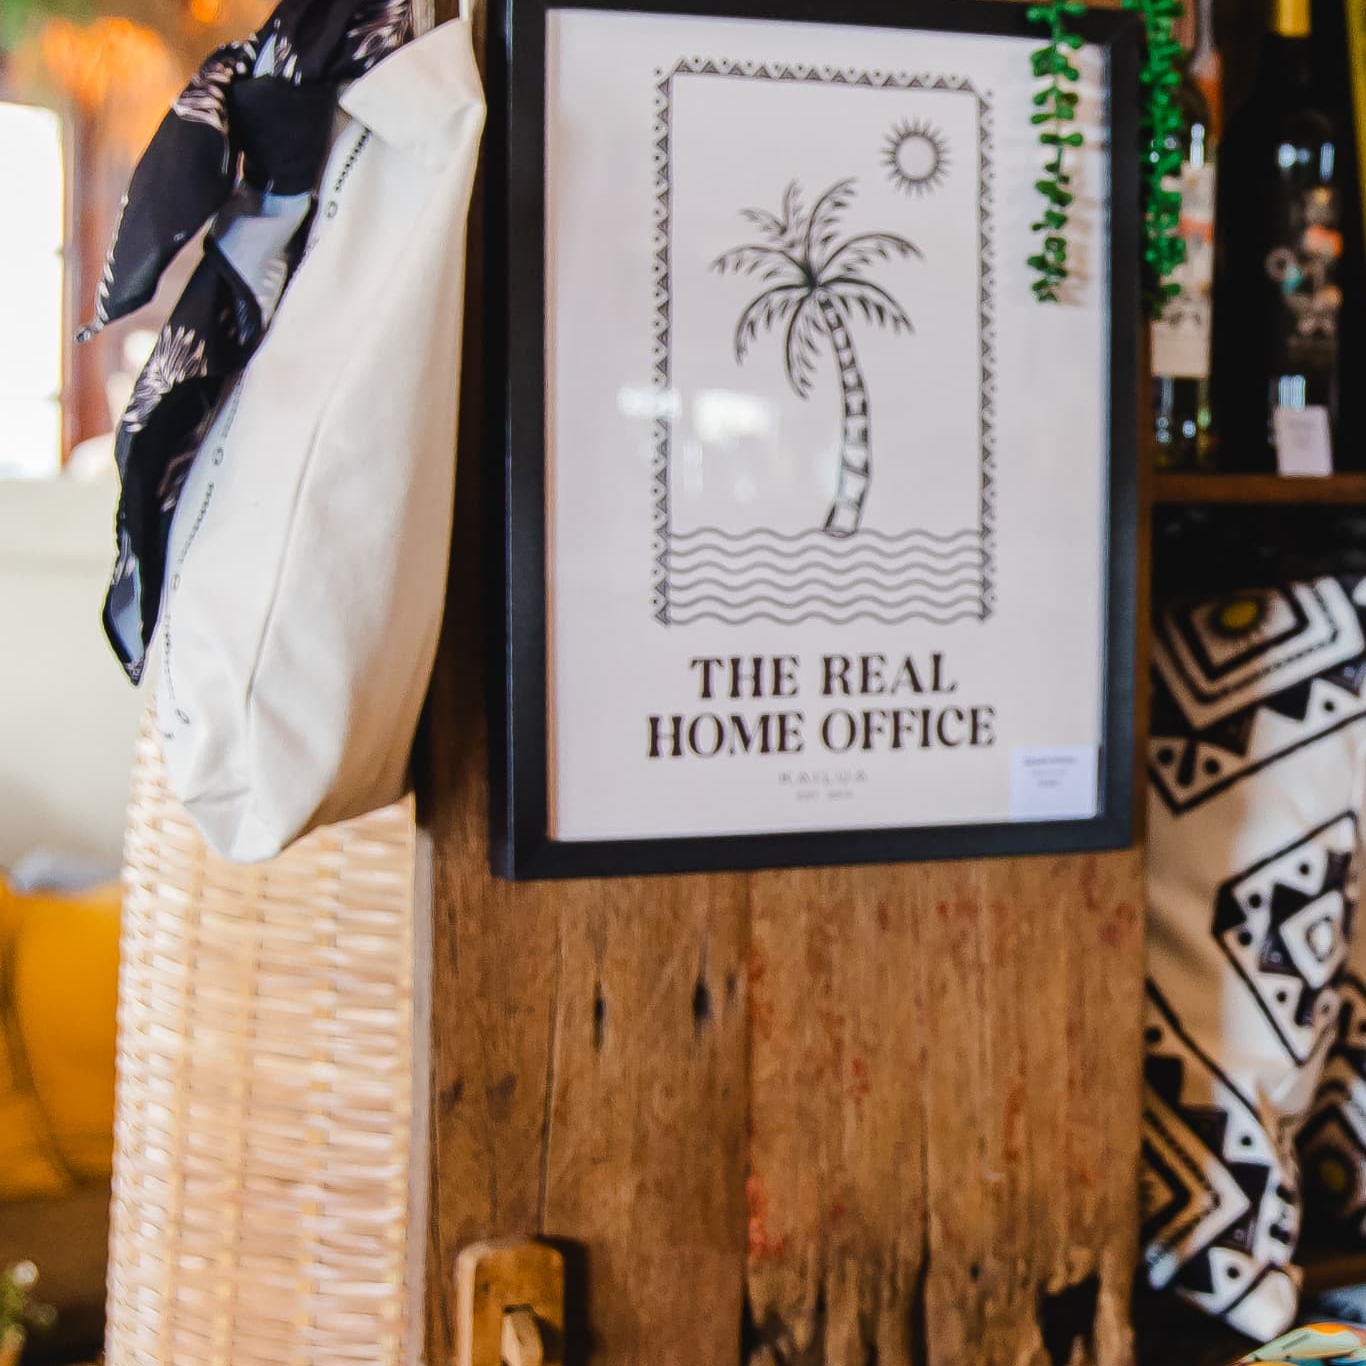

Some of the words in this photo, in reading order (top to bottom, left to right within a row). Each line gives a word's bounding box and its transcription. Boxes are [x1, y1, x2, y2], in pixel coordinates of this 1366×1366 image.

[690, 654, 801, 699] THE
[820, 650, 958, 696] REAL
[647, 710, 805, 757] HOME
[820, 705, 995, 752] OFFICE
